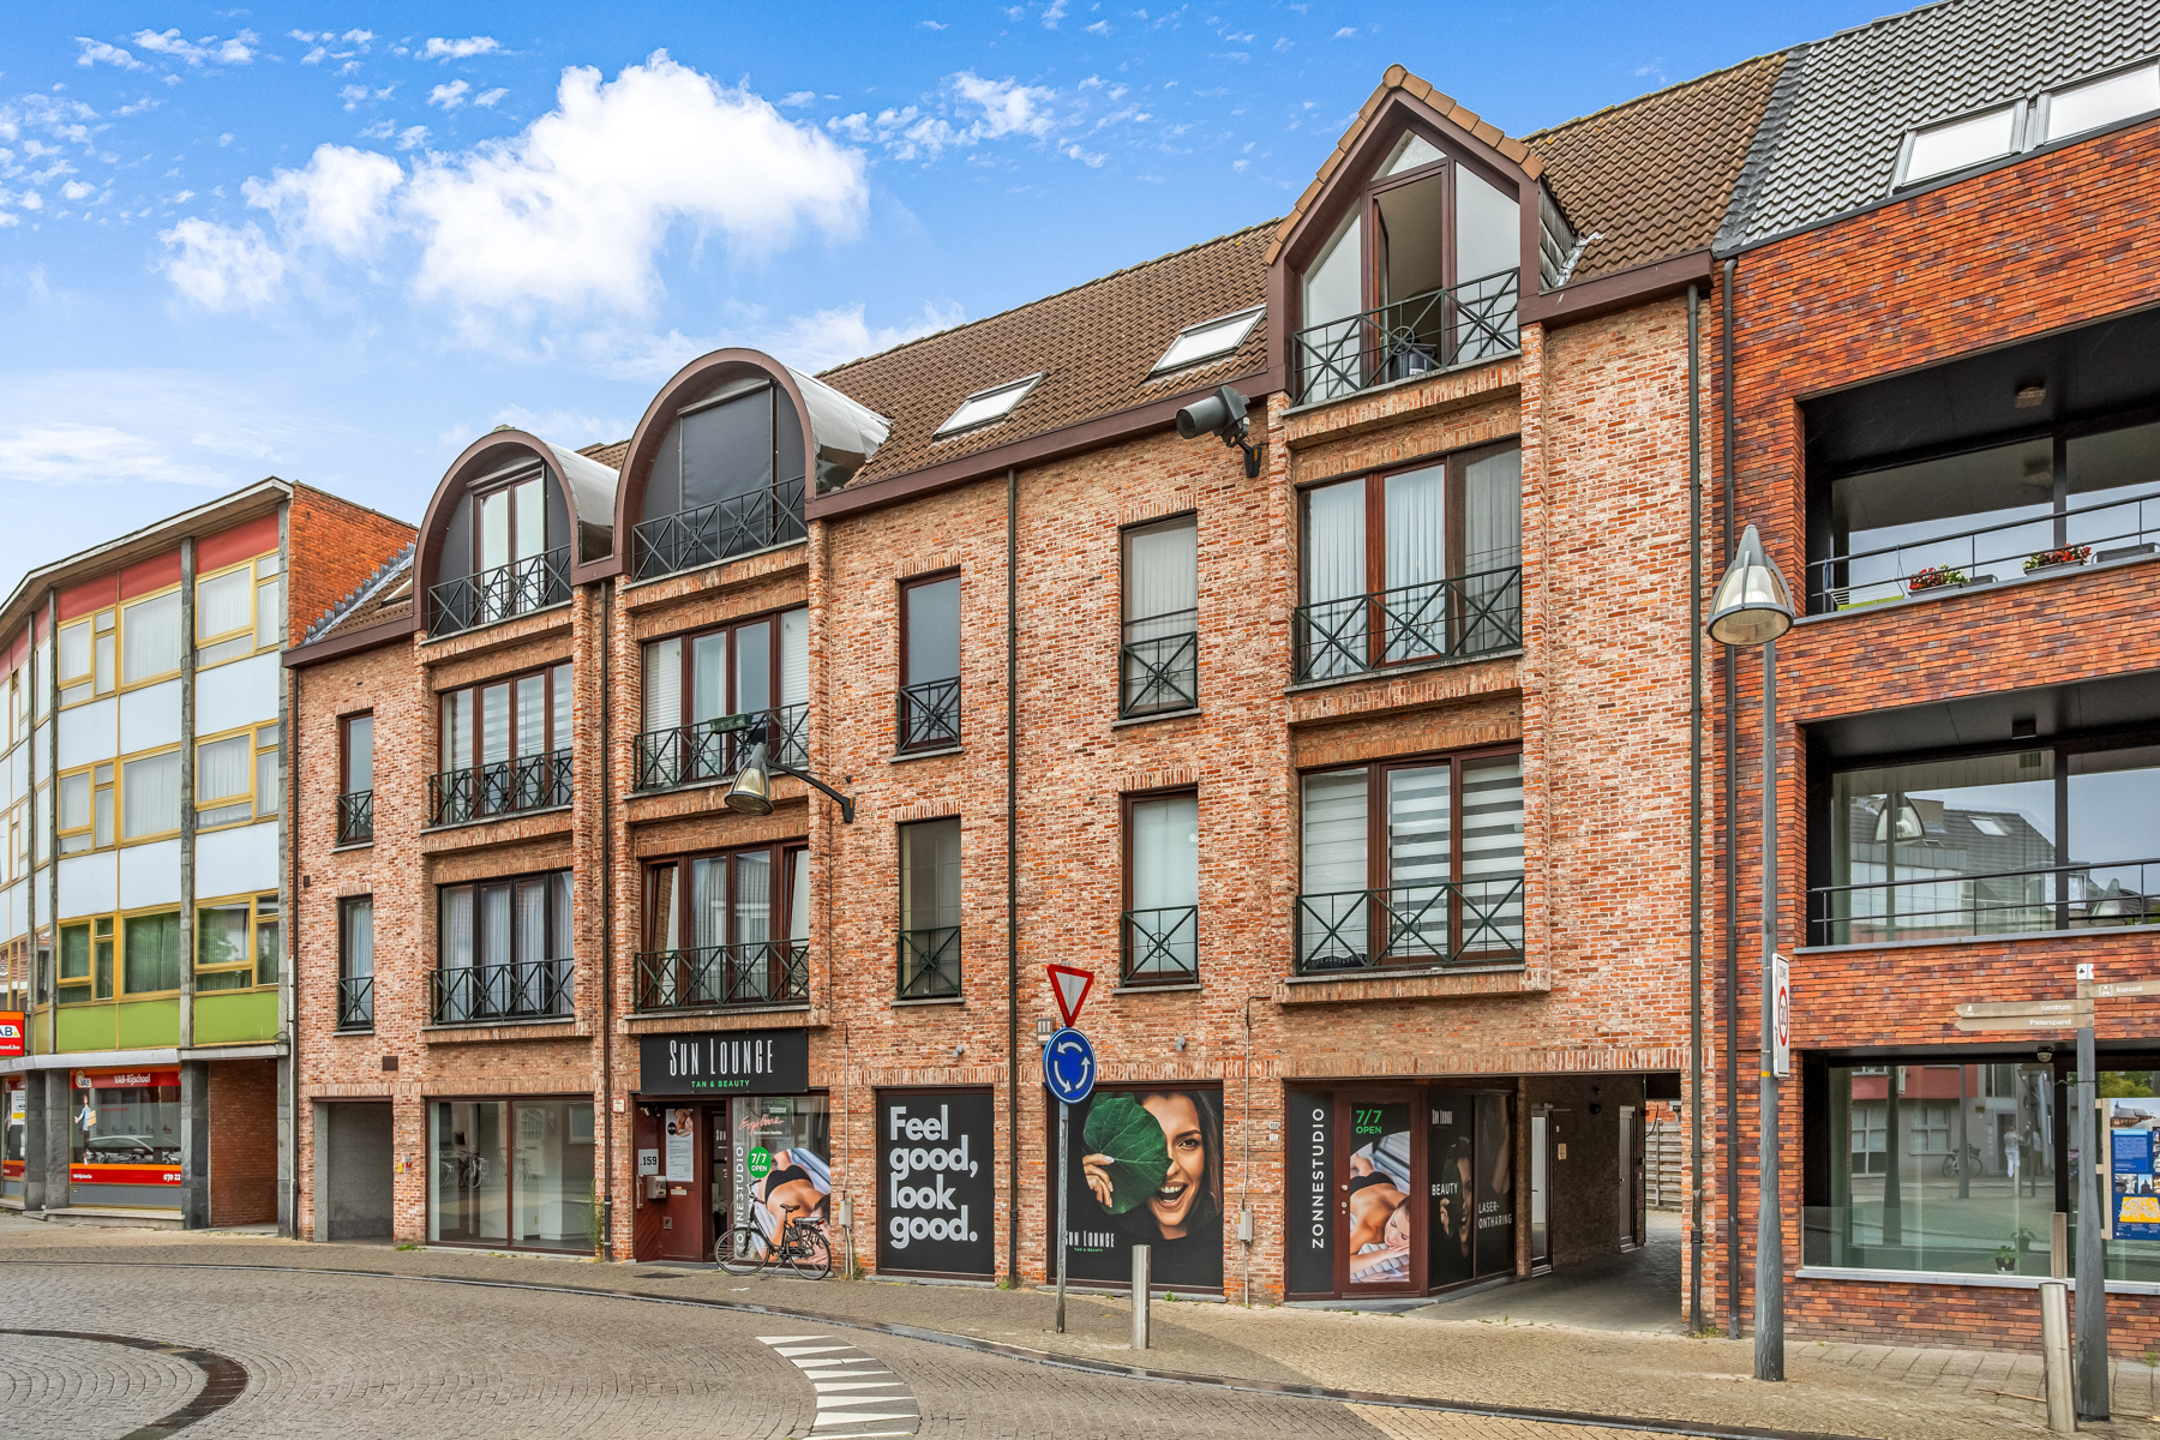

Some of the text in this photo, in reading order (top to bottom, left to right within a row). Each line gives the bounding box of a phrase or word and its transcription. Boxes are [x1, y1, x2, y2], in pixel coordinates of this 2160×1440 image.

[2116, 985, 2142, 993] kanaal
[2041, 1003, 2072, 1011] centrum
[2029, 1018, 2072, 1027] Paterspand
[669, 1038, 773, 1077] SUN LOUNGE
[691, 1079, 750, 1088] TAN & BEAUTY
[890, 1104, 949, 1141] Feel
[1355, 1108, 1382, 1125] 7/7
[1355, 1126, 1382, 1134] OPEN
[751, 1152, 767, 1164] 7/7
[889, 1134, 979, 1181] good,
[163, 1173, 174, 1182] 070
[1312, 1108, 1324, 1249] ZONNESTUDIO
[890, 1172, 957, 1210] look
[1431, 1182, 1459, 1196] BEAUTY
[1478, 1200, 1500, 1214] LASER-
[889, 1204, 979, 1249] good.
[1478, 1213, 1512, 1229] ONTHARING
[1083, 1230, 1115, 1248] LOUNGE
